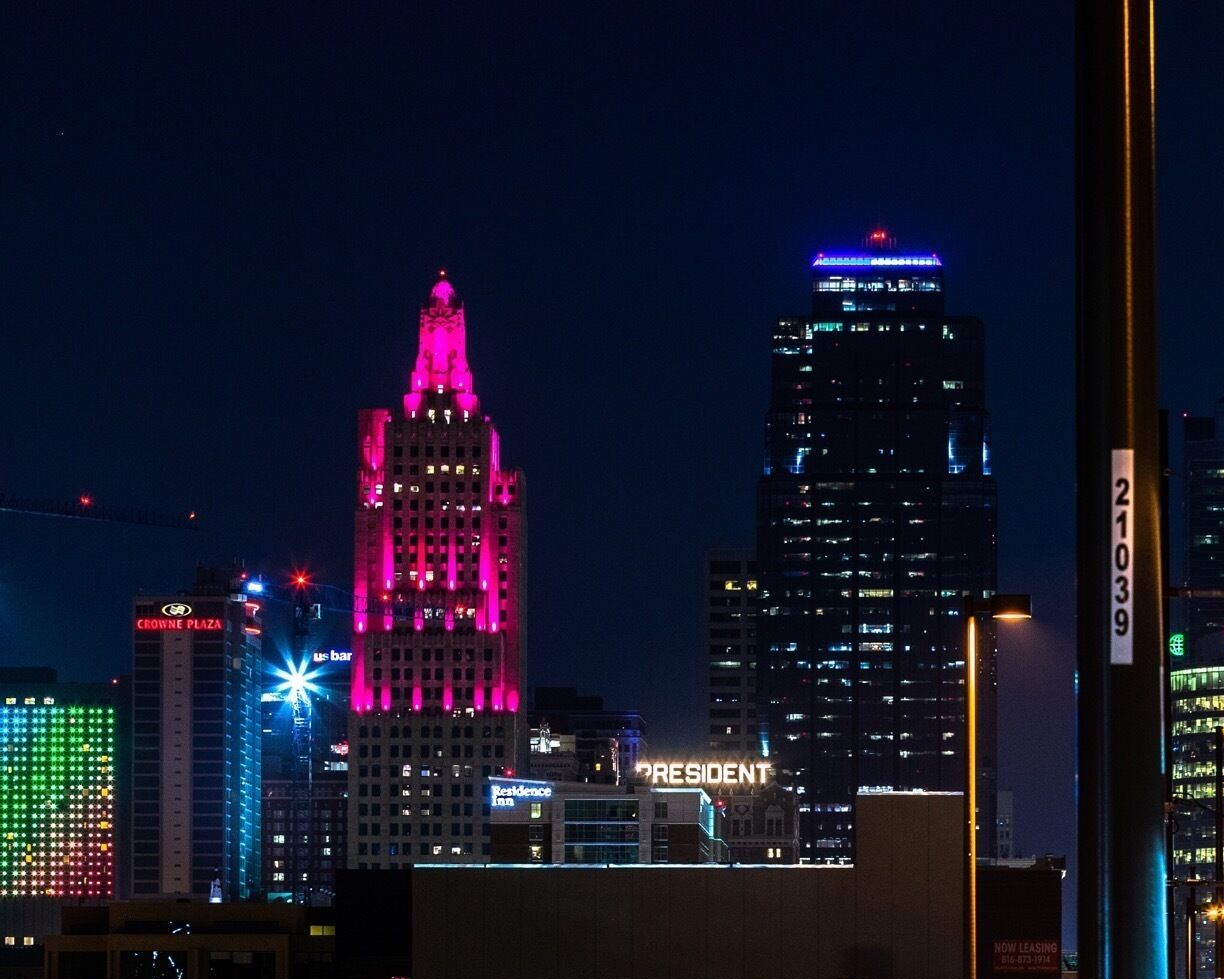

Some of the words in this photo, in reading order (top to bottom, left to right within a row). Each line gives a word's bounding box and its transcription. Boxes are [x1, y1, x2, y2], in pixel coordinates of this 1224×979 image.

[1115, 478, 1130, 637] 21039
[137, 619, 183, 630] CROWNE
[187, 619, 222, 630] PLAZA
[635, 762, 772, 784] PRESIDENT
[491, 785, 552, 797] Residence
[491, 796, 515, 807] Inn
[994, 942, 1017, 953] NOW
[1019, 942, 1058, 953] LEASING
